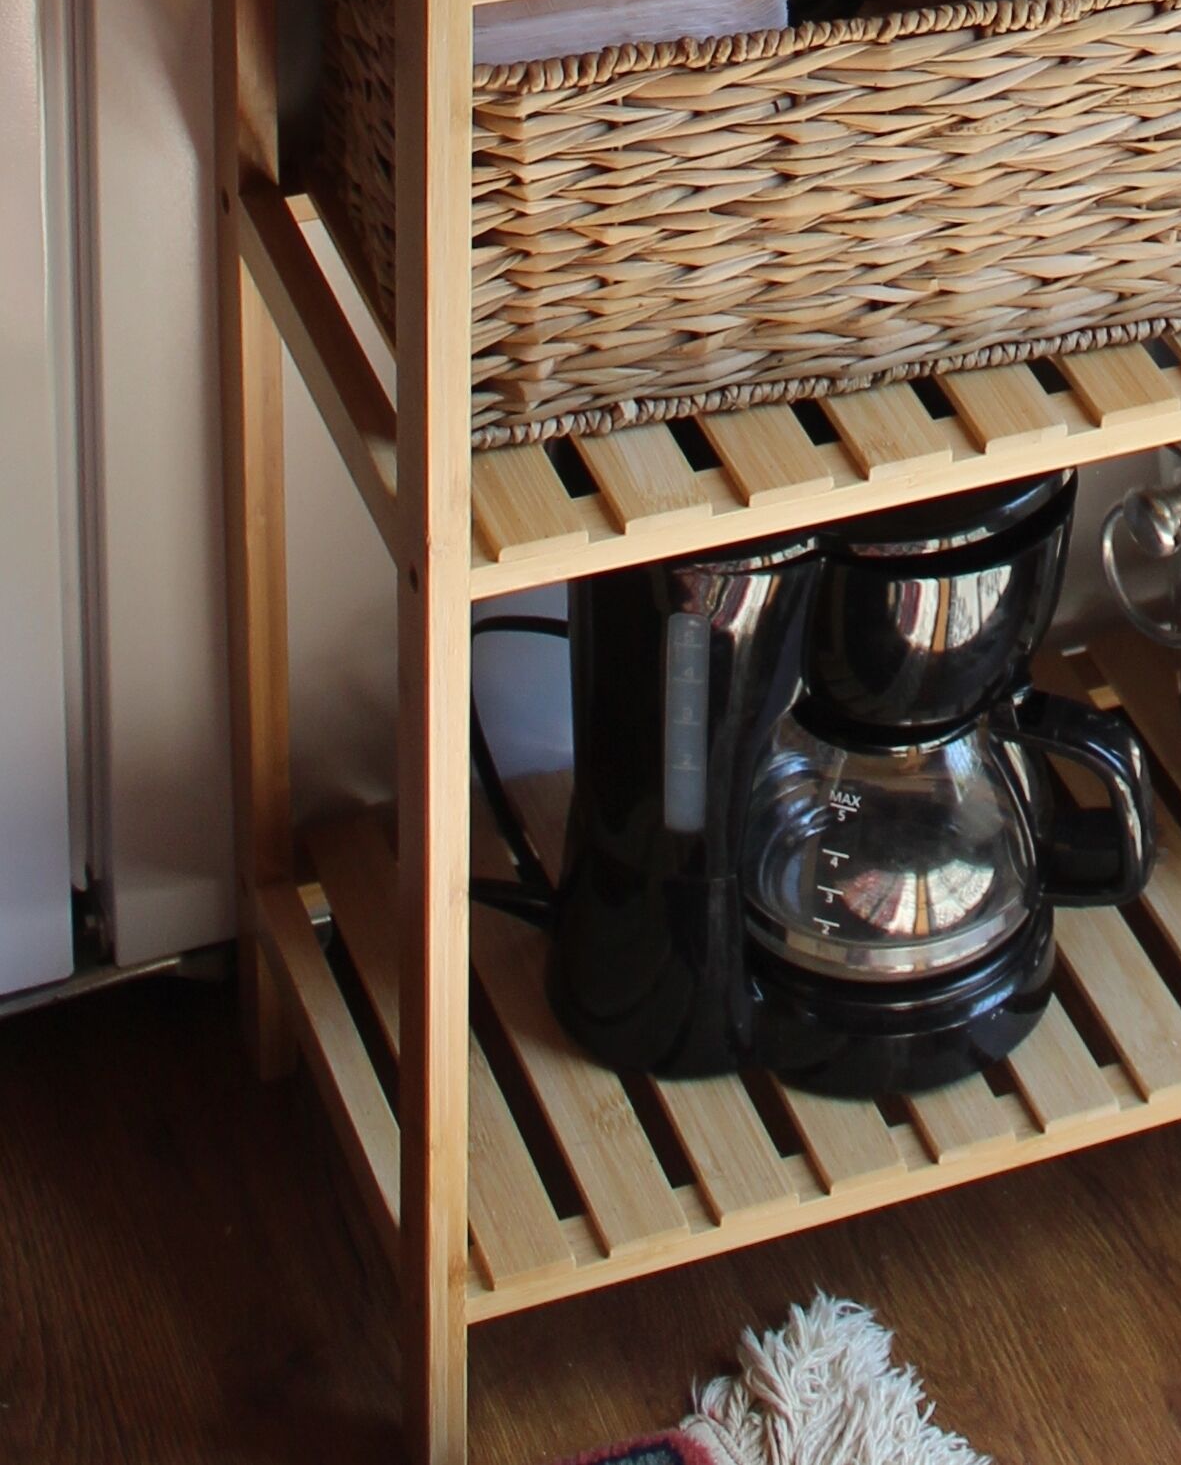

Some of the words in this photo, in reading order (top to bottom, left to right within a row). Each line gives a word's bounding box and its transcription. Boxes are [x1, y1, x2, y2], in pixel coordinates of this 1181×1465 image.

[829, 789, 862, 808] MAX
[837, 809, 847, 823] 5
[829, 855, 840, 869] 4
[824, 891, 834, 904] 3
[821, 923, 830, 936] 2
